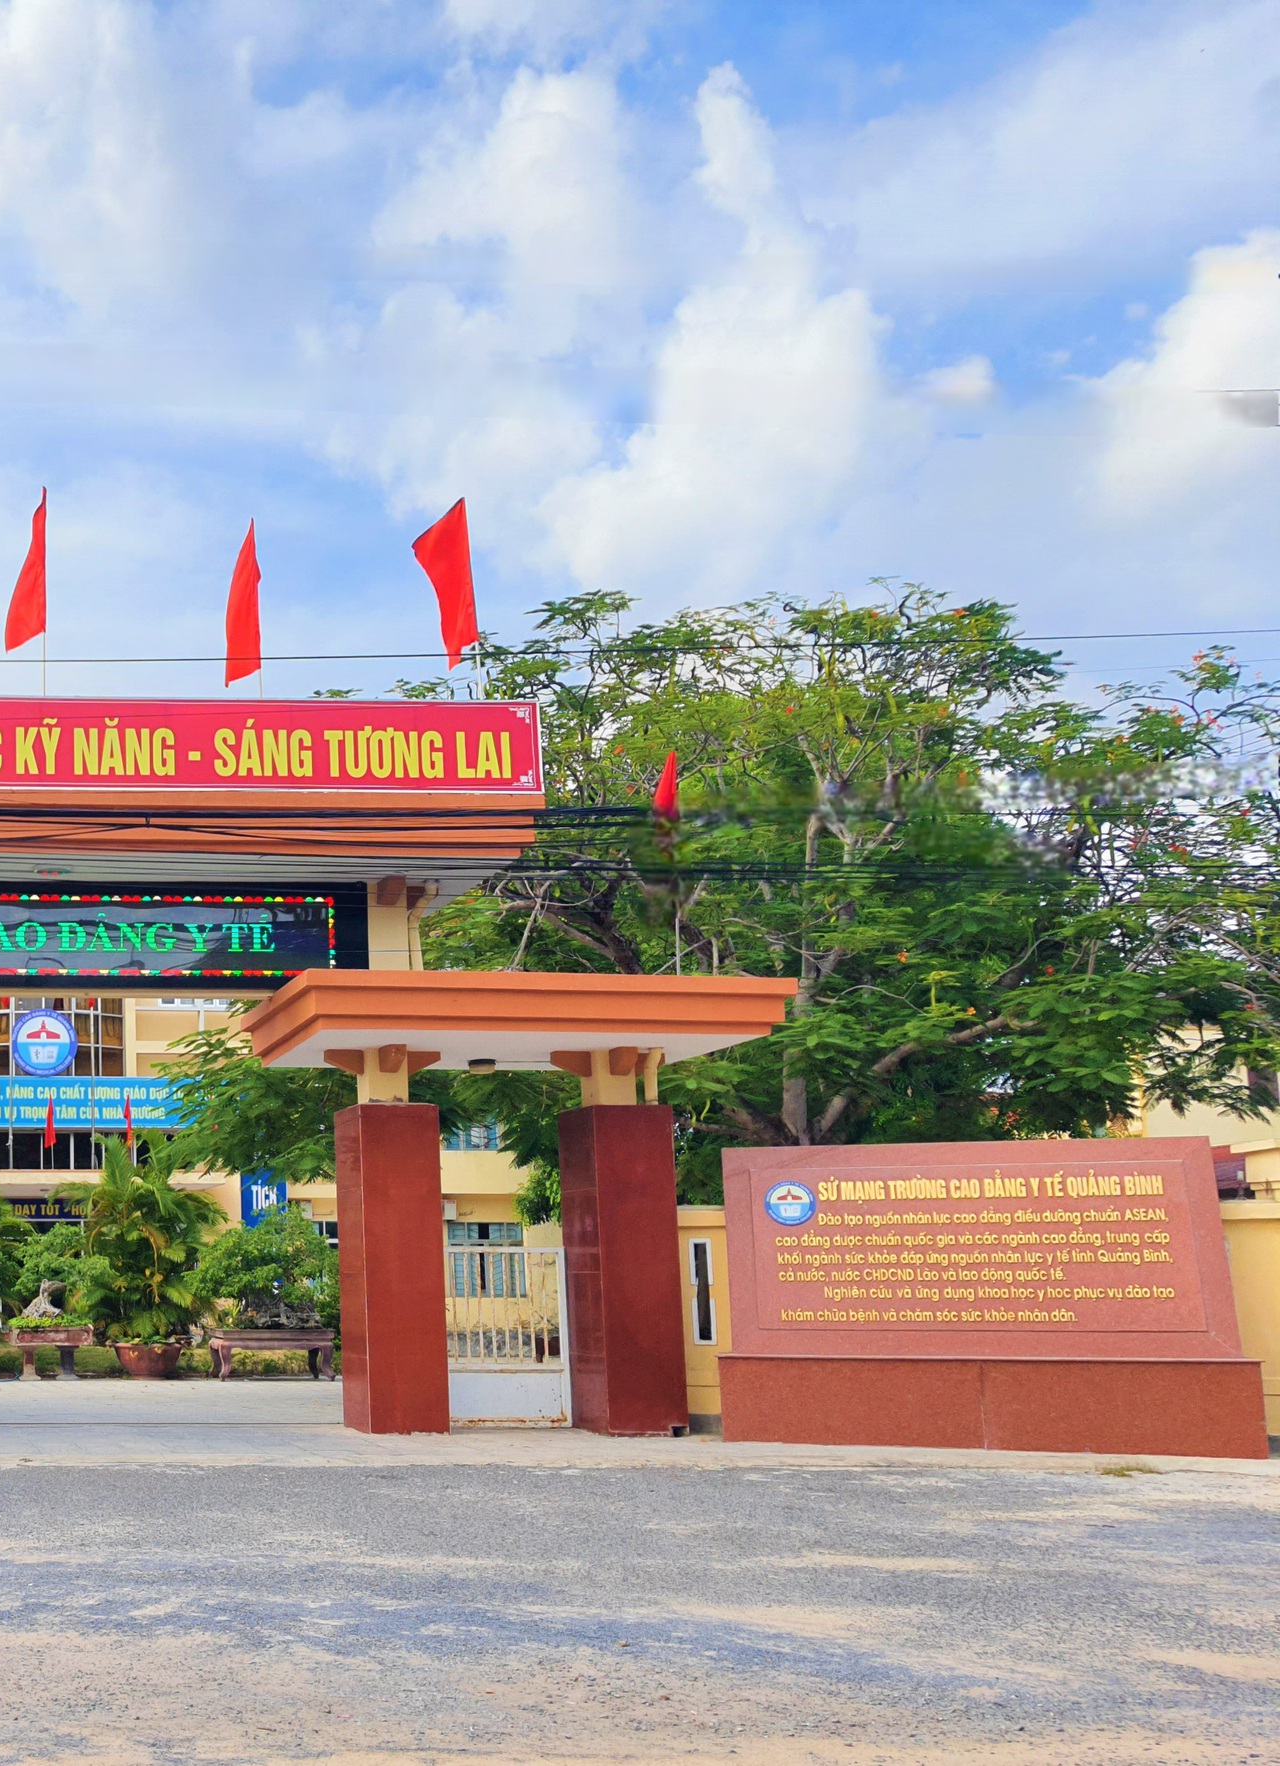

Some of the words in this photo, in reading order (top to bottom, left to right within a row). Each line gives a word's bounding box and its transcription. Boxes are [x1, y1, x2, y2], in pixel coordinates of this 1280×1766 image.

[15, 717, 61, 775] KỸ
[73, 717, 176, 776] NĂNG
[214, 719, 313, 777] SÁNG
[324, 726, 445, 779] TƯƠNG
[456, 731, 512, 779] LAI
[184, 923, 213, 952] Y
[222, 914, 275, 952] TẾ
[6, 1084, 34, 1099] NÂNG
[37, 1086, 57, 1099] CAO
[60, 1083, 85, 1100] CHẤT
[88, 1086, 120, 1102] LƯỢNG
[123, 1085, 147, 1100] GIÁO
[20, 1106, 48, 1122] TRỌN
[55, 1104, 77, 1119] TÂM
[80, 1102, 100, 1119] CỦA
[102, 1105, 124, 1119] NHÀ
[129, 1104, 165, 1119] RƯỜNG
[818, 1177, 839, 1201] SỨ
[841, 1180, 885, 1204] MẠNG
[887, 1174, 947, 1200] TRƯỜNG
[950, 1178, 980, 1199] CAO
[984, 1169, 1027, 1198] ĐẲNG
[1029, 1178, 1040, 1198] Y
[1044, 1171, 1064, 1197] TẾ
[1066, 1169, 1121, 1198] QUẢNG
[1124, 1171, 1164, 1196] BÌNH
[71, 1204, 87, 1218] HỌ
[818, 1212, 842, 1226] Đào
[844, 1213, 863, 1227] tạo
[903, 1211, 932, 1224] nhân
[934, 1211, 951, 1227] lực
[953, 1213, 977, 1224] cao
[1083, 1205, 1121, 1221] chuẩn
[1124, 1208, 1169, 1222] ASEAN,
[775, 1236, 798, 1247] cao
[865, 1230, 901, 1246] chuẩn
[903, 1231, 934, 1248] quốc
[936, 1233, 956, 1248] gia
[958, 1231, 973, 1245] và
[975, 1231, 999, 1245] các
[1002, 1231, 1039, 1248] ngành
[1042, 1233, 1067, 1244] cao
[1106, 1230, 1140, 1246] trung
[1144, 1229, 1170, 1245] cấp
[805, 1251, 842, 1267] ngành
[845, 1252, 865, 1264] sức
[868, 1249, 898, 1264] khỏe
[900, 1251, 924, 1265] đáp
[926, 1251, 949, 1267] ứng
[991, 1251, 1022, 1263] nhân
[1024, 1251, 1044, 1265] lực
[1046, 1253, 1053, 1265] y
[1056, 1248, 1070, 1262] tế
[1072, 1248, 1095, 1262] tỉnh
[1097, 1247, 1141, 1265] Quảng
[1143, 1248, 1174, 1263] Bình,
[778, 1267, 794, 1281] cả
[797, 1268, 829, 1282] nước,
[831, 1268, 861, 1281] nước
[863, 1268, 914, 1281] CHDCND
[917, 1268, 939, 1281] Lào
[942, 1268, 957, 1281] và
[959, 1268, 978, 1281] lao
[981, 1268, 1013, 1283] động
[1016, 1266, 1047, 1282] quốc
[824, 1285, 867, 1301] Nghiên
[870, 1285, 892, 1298] cứu
[897, 1285, 912, 1298] và
[915, 1285, 940, 1301] ứng
[944, 1286, 975, 1301] dụng
[978, 1285, 1009, 1298] khoa
[1011, 1285, 1035, 1300] học
[1037, 1289, 1045, 1301] y
[1073, 1285, 1105, 1301] phục
[1107, 1287, 1122, 1301] vụ
[1125, 1284, 1151, 1298] đào
[1153, 1285, 1175, 1301] tạo
[781, 1308, 814, 1321] khám
[817, 1308, 847, 1321] chữa
[849, 1308, 880, 1324] bệnh
[882, 1308, 897, 1321] và
[899, 1308, 934, 1321] chăm
[936, 1308, 958, 1321] sóc
[961, 1308, 982, 1321] sức
[984, 1307, 1015, 1321] khỏe
[1018, 1309, 1049, 1321] nhân
